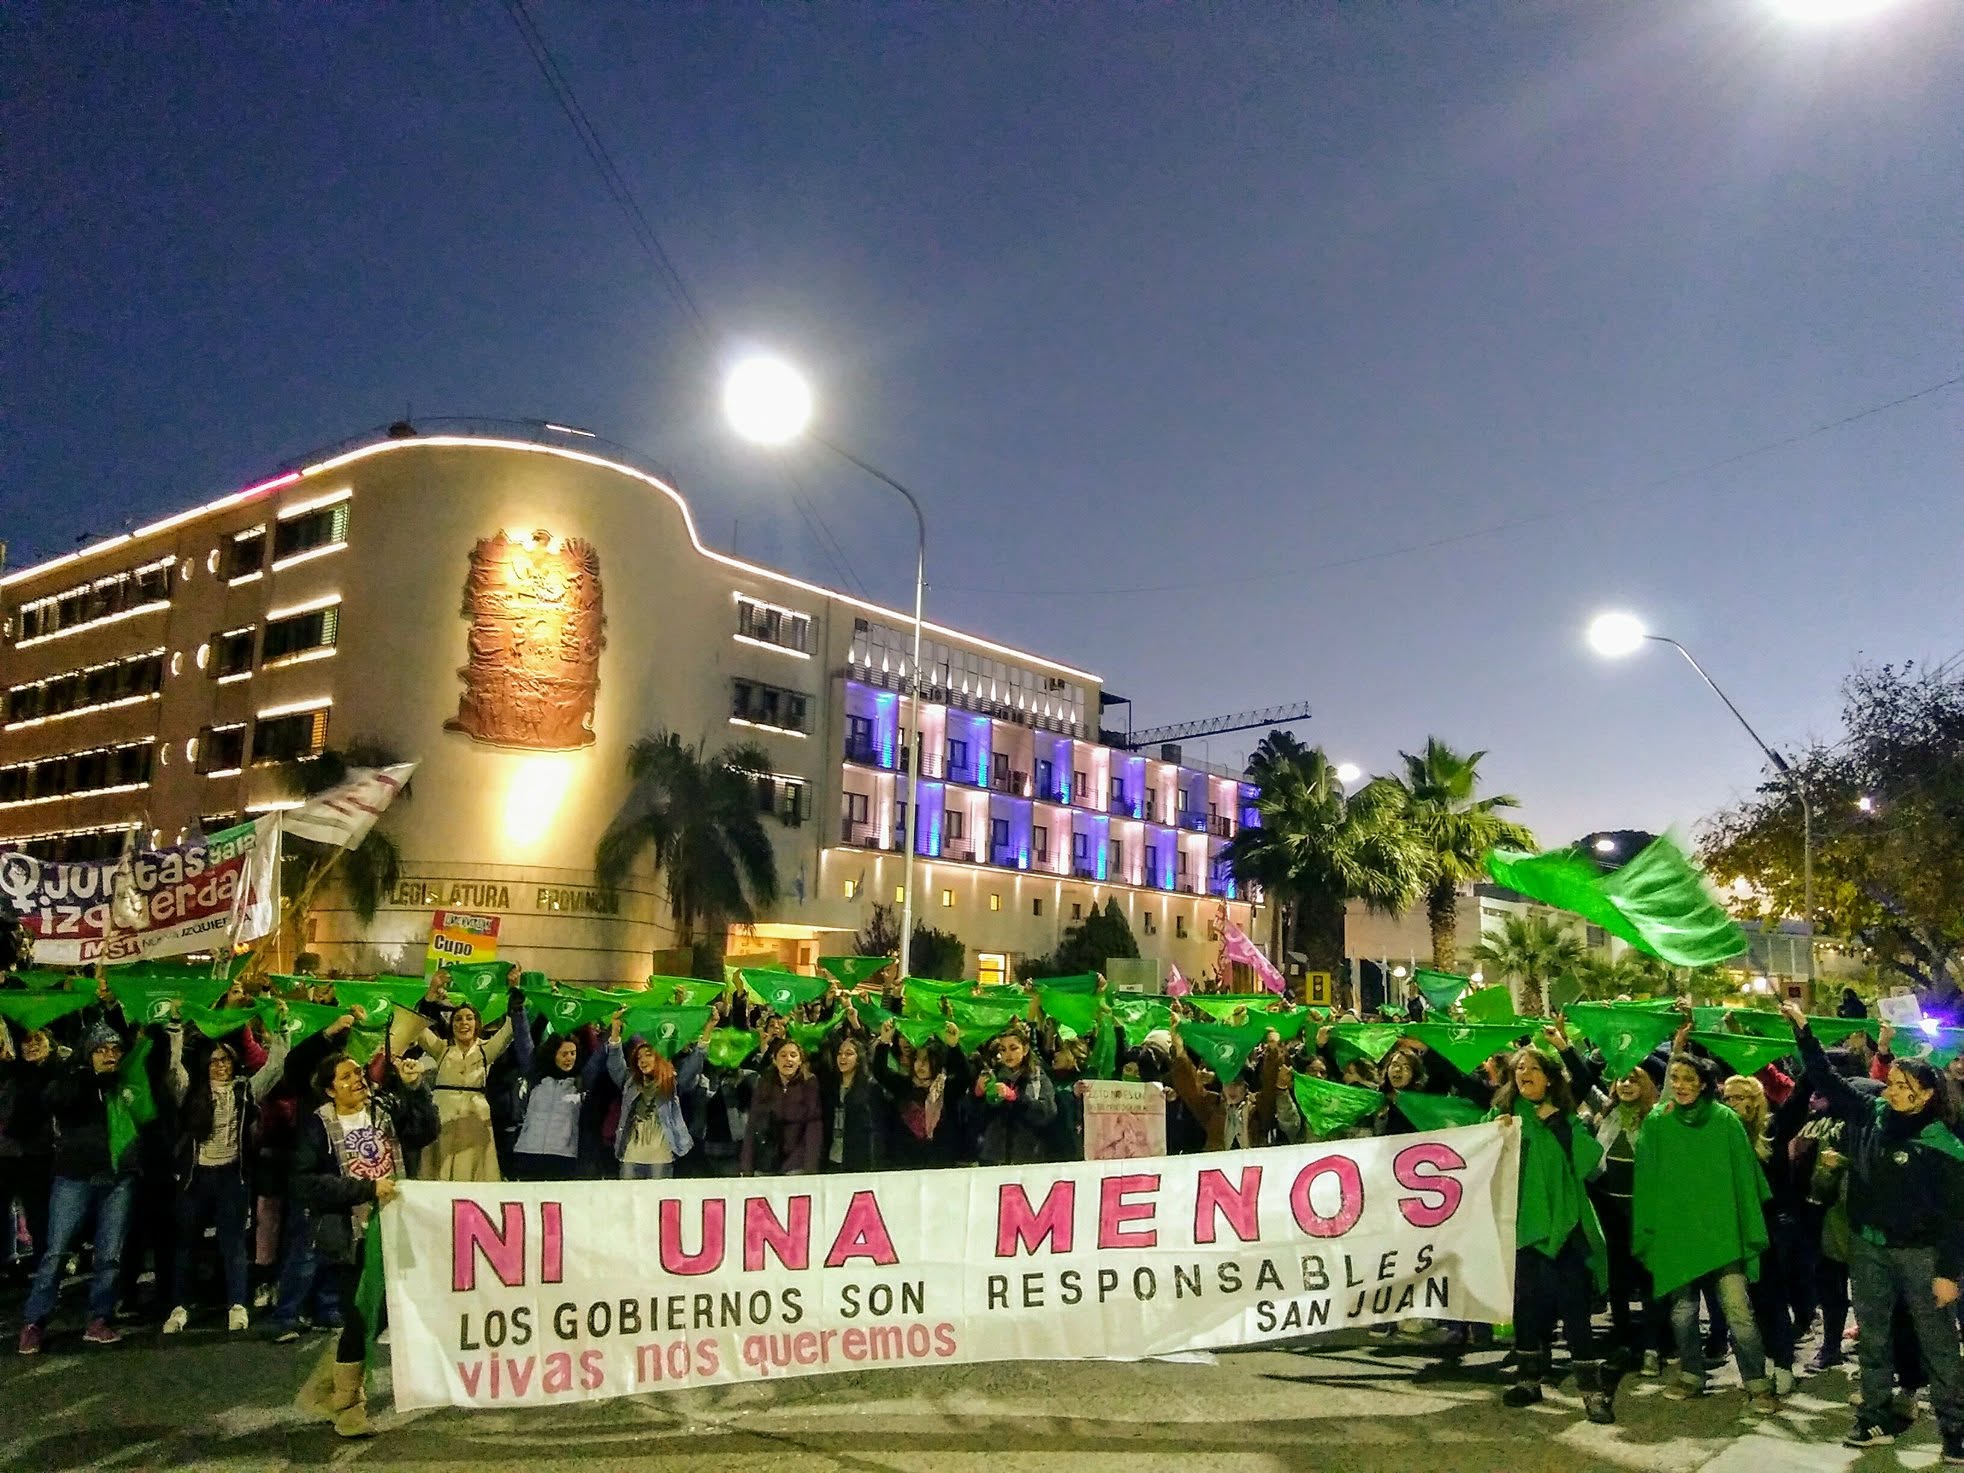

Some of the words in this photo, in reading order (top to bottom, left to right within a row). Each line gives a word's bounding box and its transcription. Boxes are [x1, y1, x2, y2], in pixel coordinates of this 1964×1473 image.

[181, 912, 252, 937] IZQUIEA
[434, 934, 473, 956] Cupo
[451, 1198, 563, 1292] NI
[658, 1190, 900, 1276] UNA
[995, 1142, 1468, 1257] MENOS
[460, 1306, 532, 1351] LOS
[553, 1287, 803, 1341] GOBIERNOS
[840, 1281, 926, 1319] SON
[988, 1244, 1434, 1310] RESPONSABLES
[1256, 1297, 1330, 1333] SAN
[1346, 1276, 1449, 1319] JUAN
[457, 1346, 605, 1399] vivas
[635, 1332, 720, 1383] nos
[744, 1321, 957, 1375] queremos
